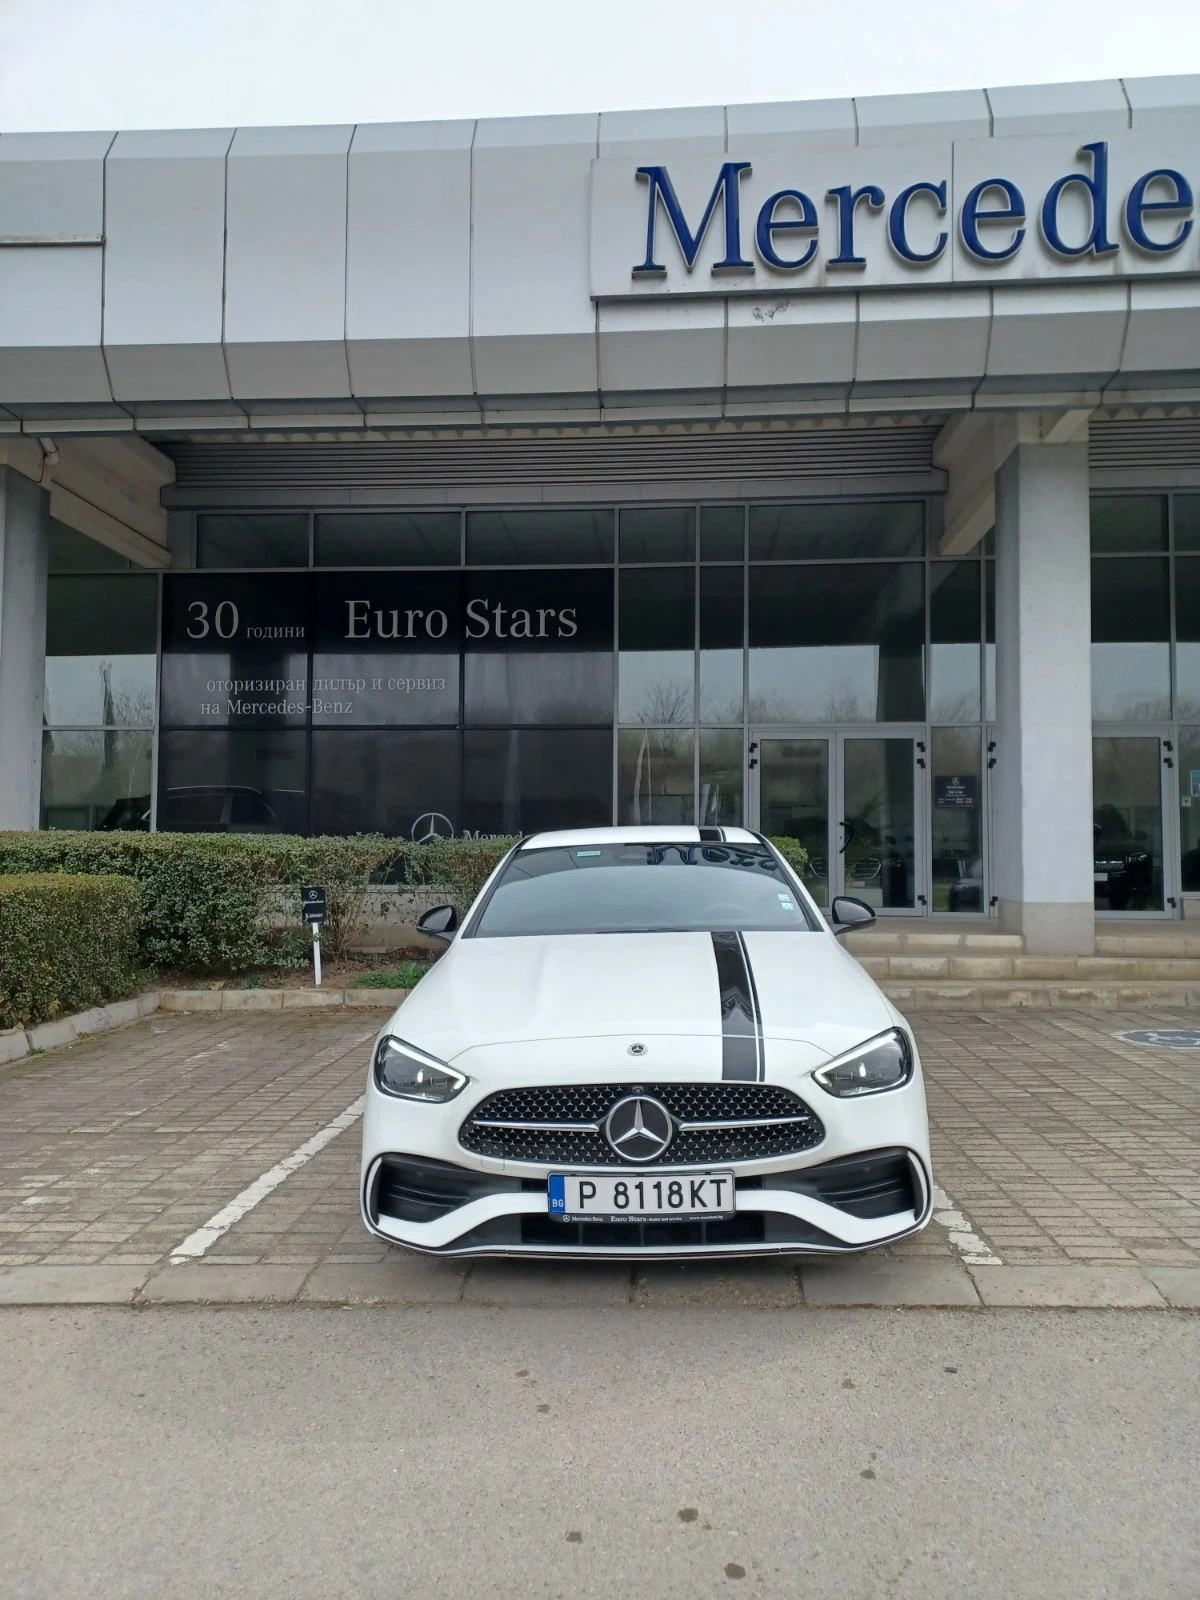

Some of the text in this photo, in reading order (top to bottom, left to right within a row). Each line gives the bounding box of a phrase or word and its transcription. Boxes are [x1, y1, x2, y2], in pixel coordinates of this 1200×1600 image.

[632, 141, 1195, 279] Mercede
[186, 601, 305, 639] 30 години
[344, 599, 578, 639] Euro Stars
[206, 677, 446, 694] оторизиран дилър и сервиз
[200, 699, 353, 715] на Mercedes-Benz
[552, 1199, 564, 1208] BG
[579, 1181, 597, 1209] P
